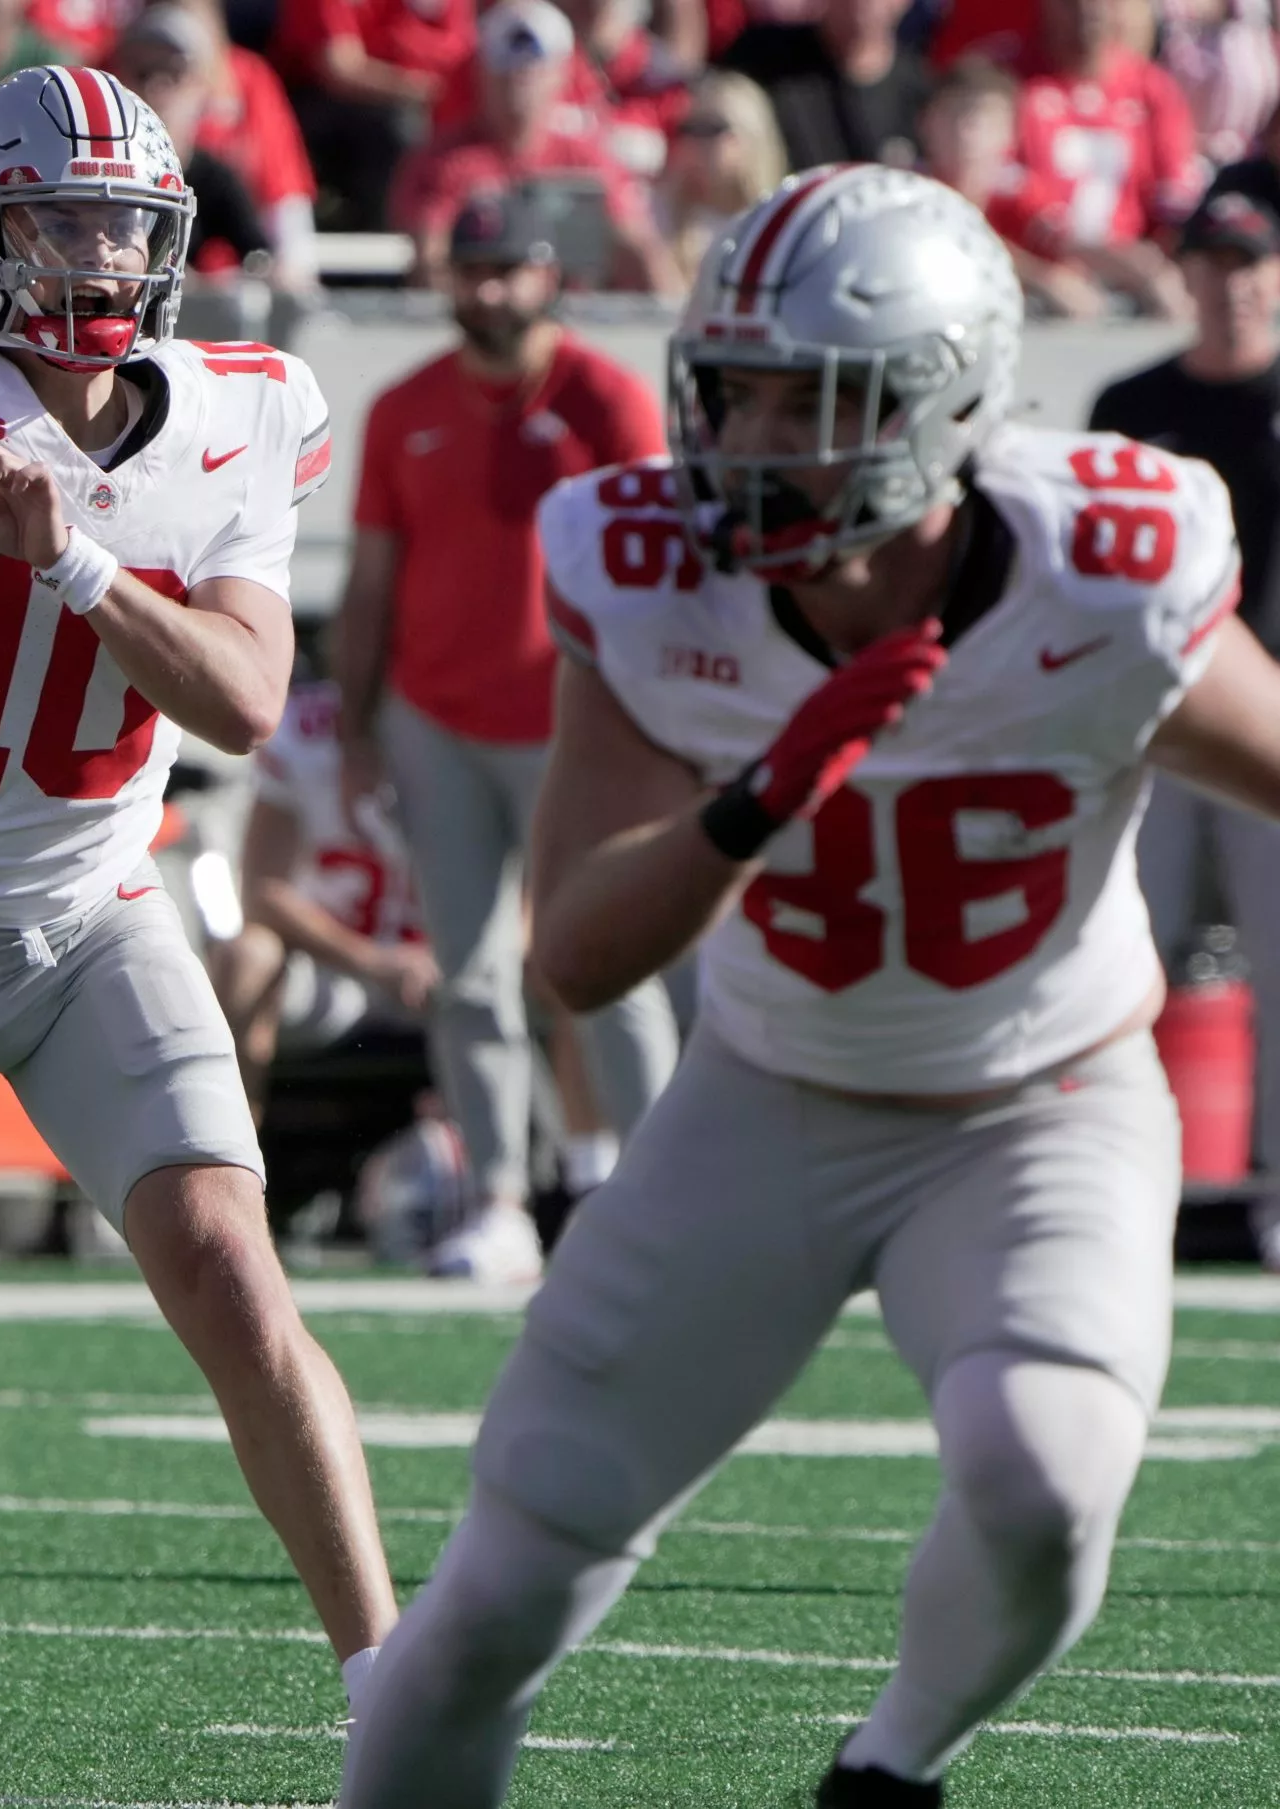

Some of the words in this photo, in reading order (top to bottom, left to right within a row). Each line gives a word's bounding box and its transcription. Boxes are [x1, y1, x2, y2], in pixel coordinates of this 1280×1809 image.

[70, 161, 100, 176] OHIO
[103, 162, 136, 179] STATE
[741, 769, 1078, 994] 86
